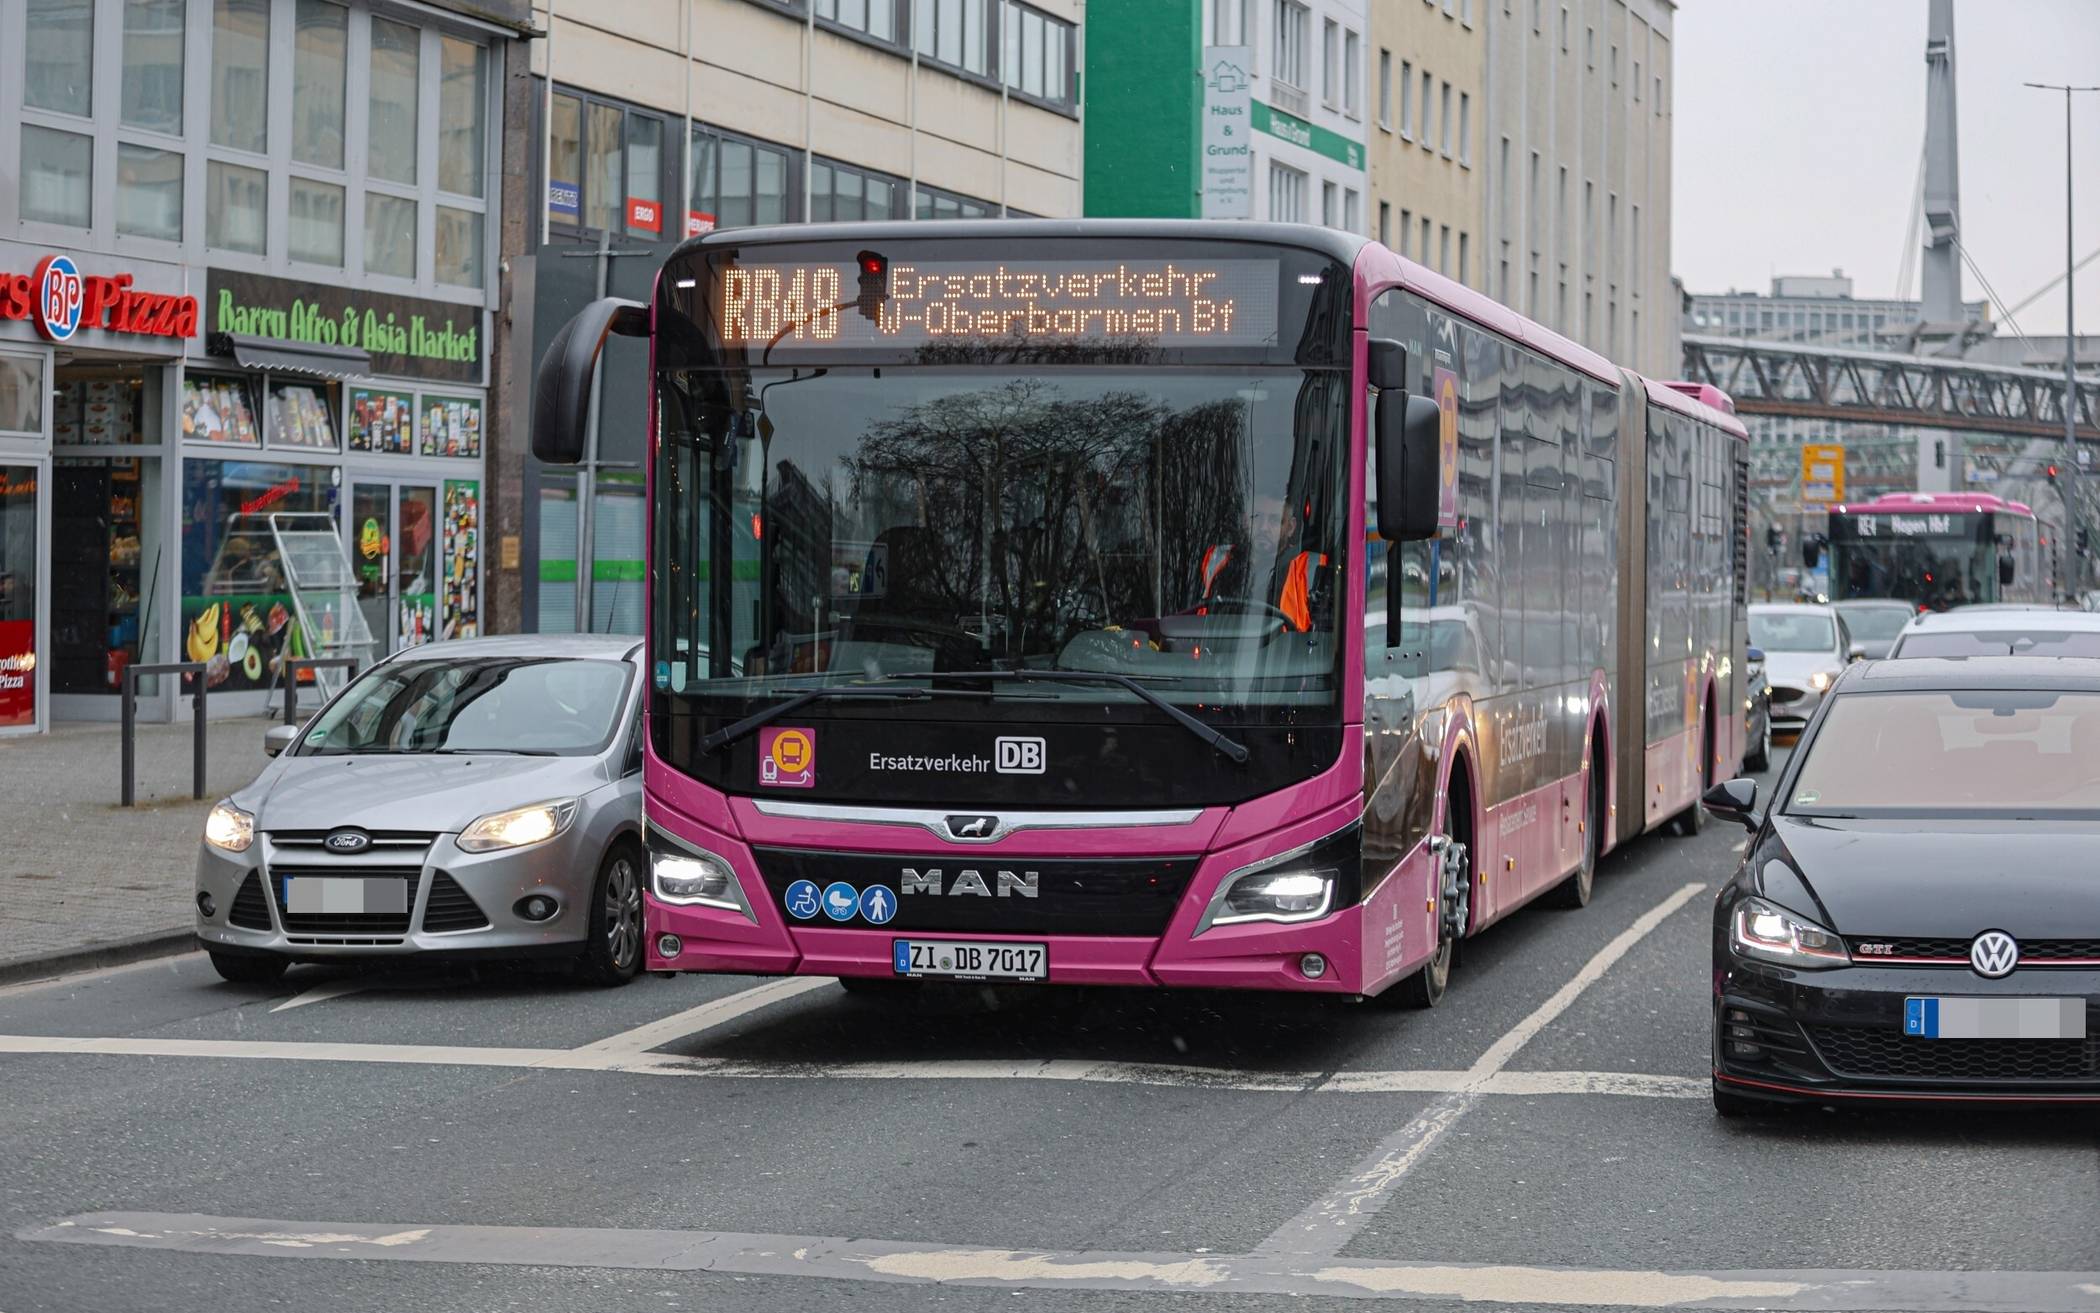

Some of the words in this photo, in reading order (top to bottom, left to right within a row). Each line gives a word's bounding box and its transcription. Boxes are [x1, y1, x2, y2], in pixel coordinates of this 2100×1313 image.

[1211, 105, 1243, 116] Haus
[1223, 125, 1233, 137] &
[1207, 144, 1248, 156] Grund
[634, 207, 653, 223] ERGO
[893, 264, 1216, 299] Ersatzverkehr
[47, 268, 80, 329] BP
[80, 273, 199, 338] Pizza
[724, 268, 838, 340] RB48
[879, 301, 1180, 334] W-Oberbarmen
[290, 299, 338, 346] Afro
[341, 306, 360, 347] &
[363, 308, 407, 354] Asia
[410, 315, 477, 362] Market
[1891, 514, 1927, 536] Hagen
[0, 674, 24, 689] Pizza
[870, 753, 991, 773] Ersatzverkehr
[999, 740, 1042, 770] DB
[335, 836, 358, 847] Ford
[901, 868, 1039, 898] MAN
[910, 945, 937, 969] ZI
[954, 946, 982, 970] DB
[987, 948, 1041, 973] 7017
[1859, 943, 1893, 955] GTI
[1910, 1019, 1918, 1028] D
